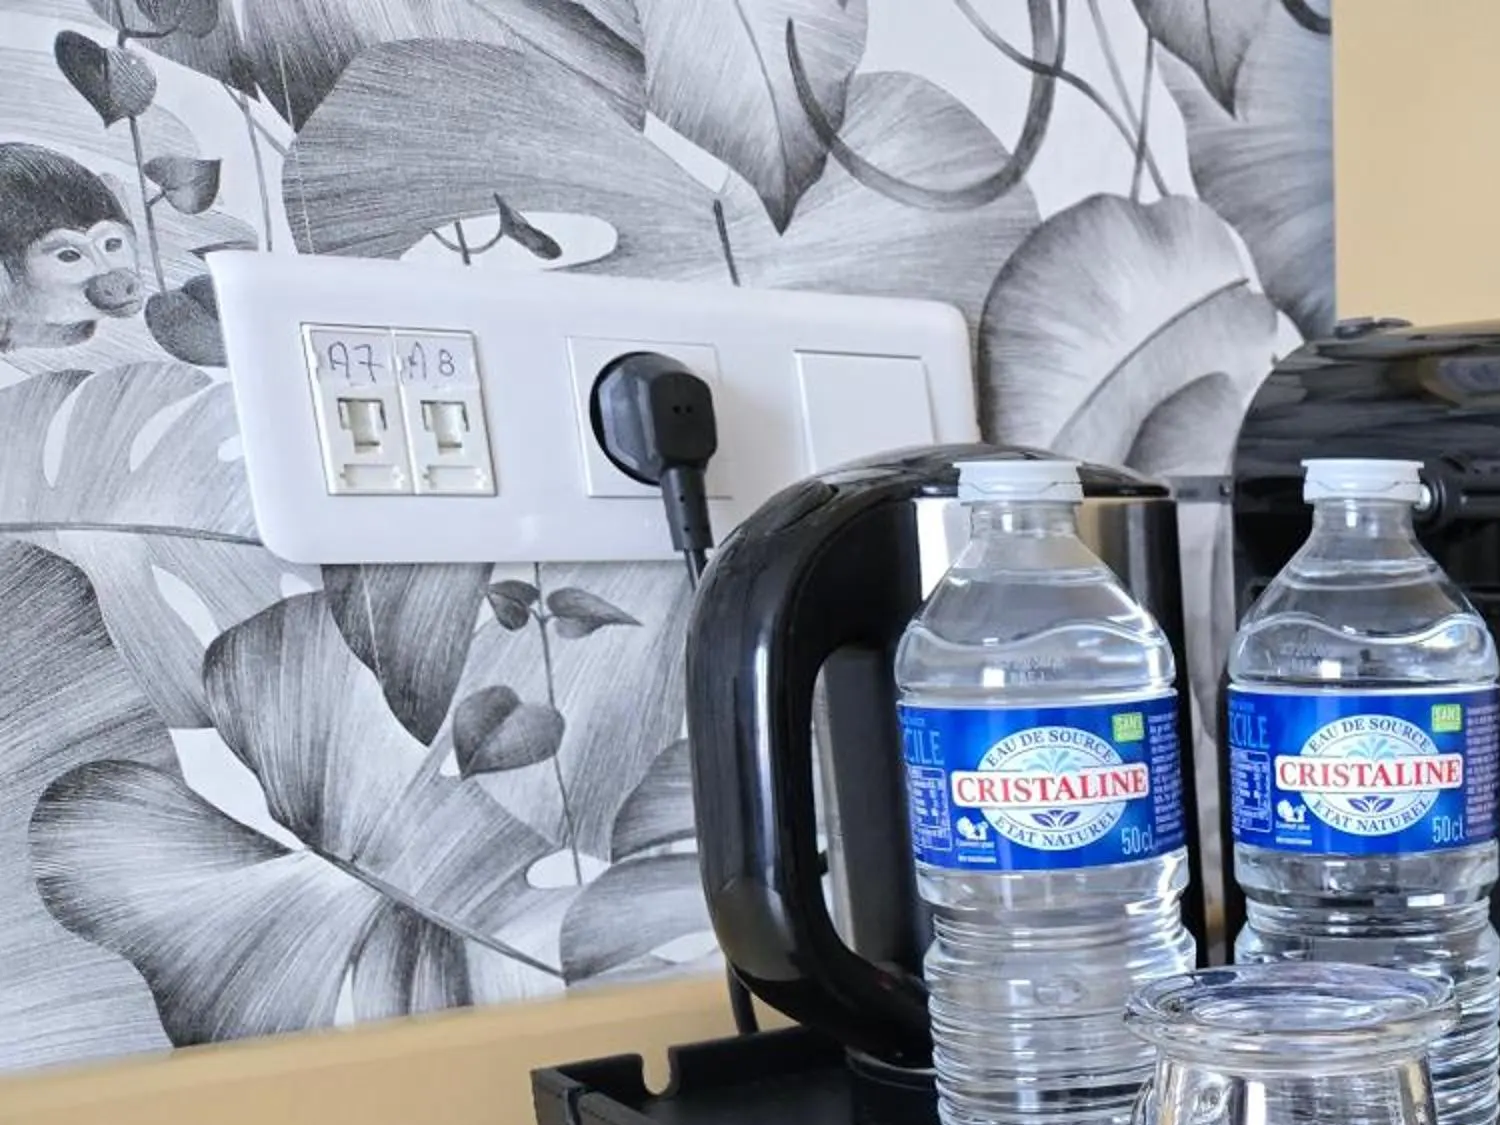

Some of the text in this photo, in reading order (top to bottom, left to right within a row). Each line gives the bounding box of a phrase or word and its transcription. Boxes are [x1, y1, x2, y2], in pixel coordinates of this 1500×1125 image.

[327, 341, 384, 383] A7
[986, 740, 1017, 767] EAU
[1020, 730, 1045, 747] DE
[1048, 729, 1114, 763] SOURCE
[1308, 717, 1432, 753] EAU DE SOURCE
[955, 767, 1148, 804] CRISTALINE
[1278, 758, 1462, 790] CRISTALINE
[1042, 811, 1116, 847] NATUREL
[1356, 798, 1429, 832] NATUREL
[1431, 814, 1466, 844] 50cl
[1121, 823, 1155, 855] 50cl
